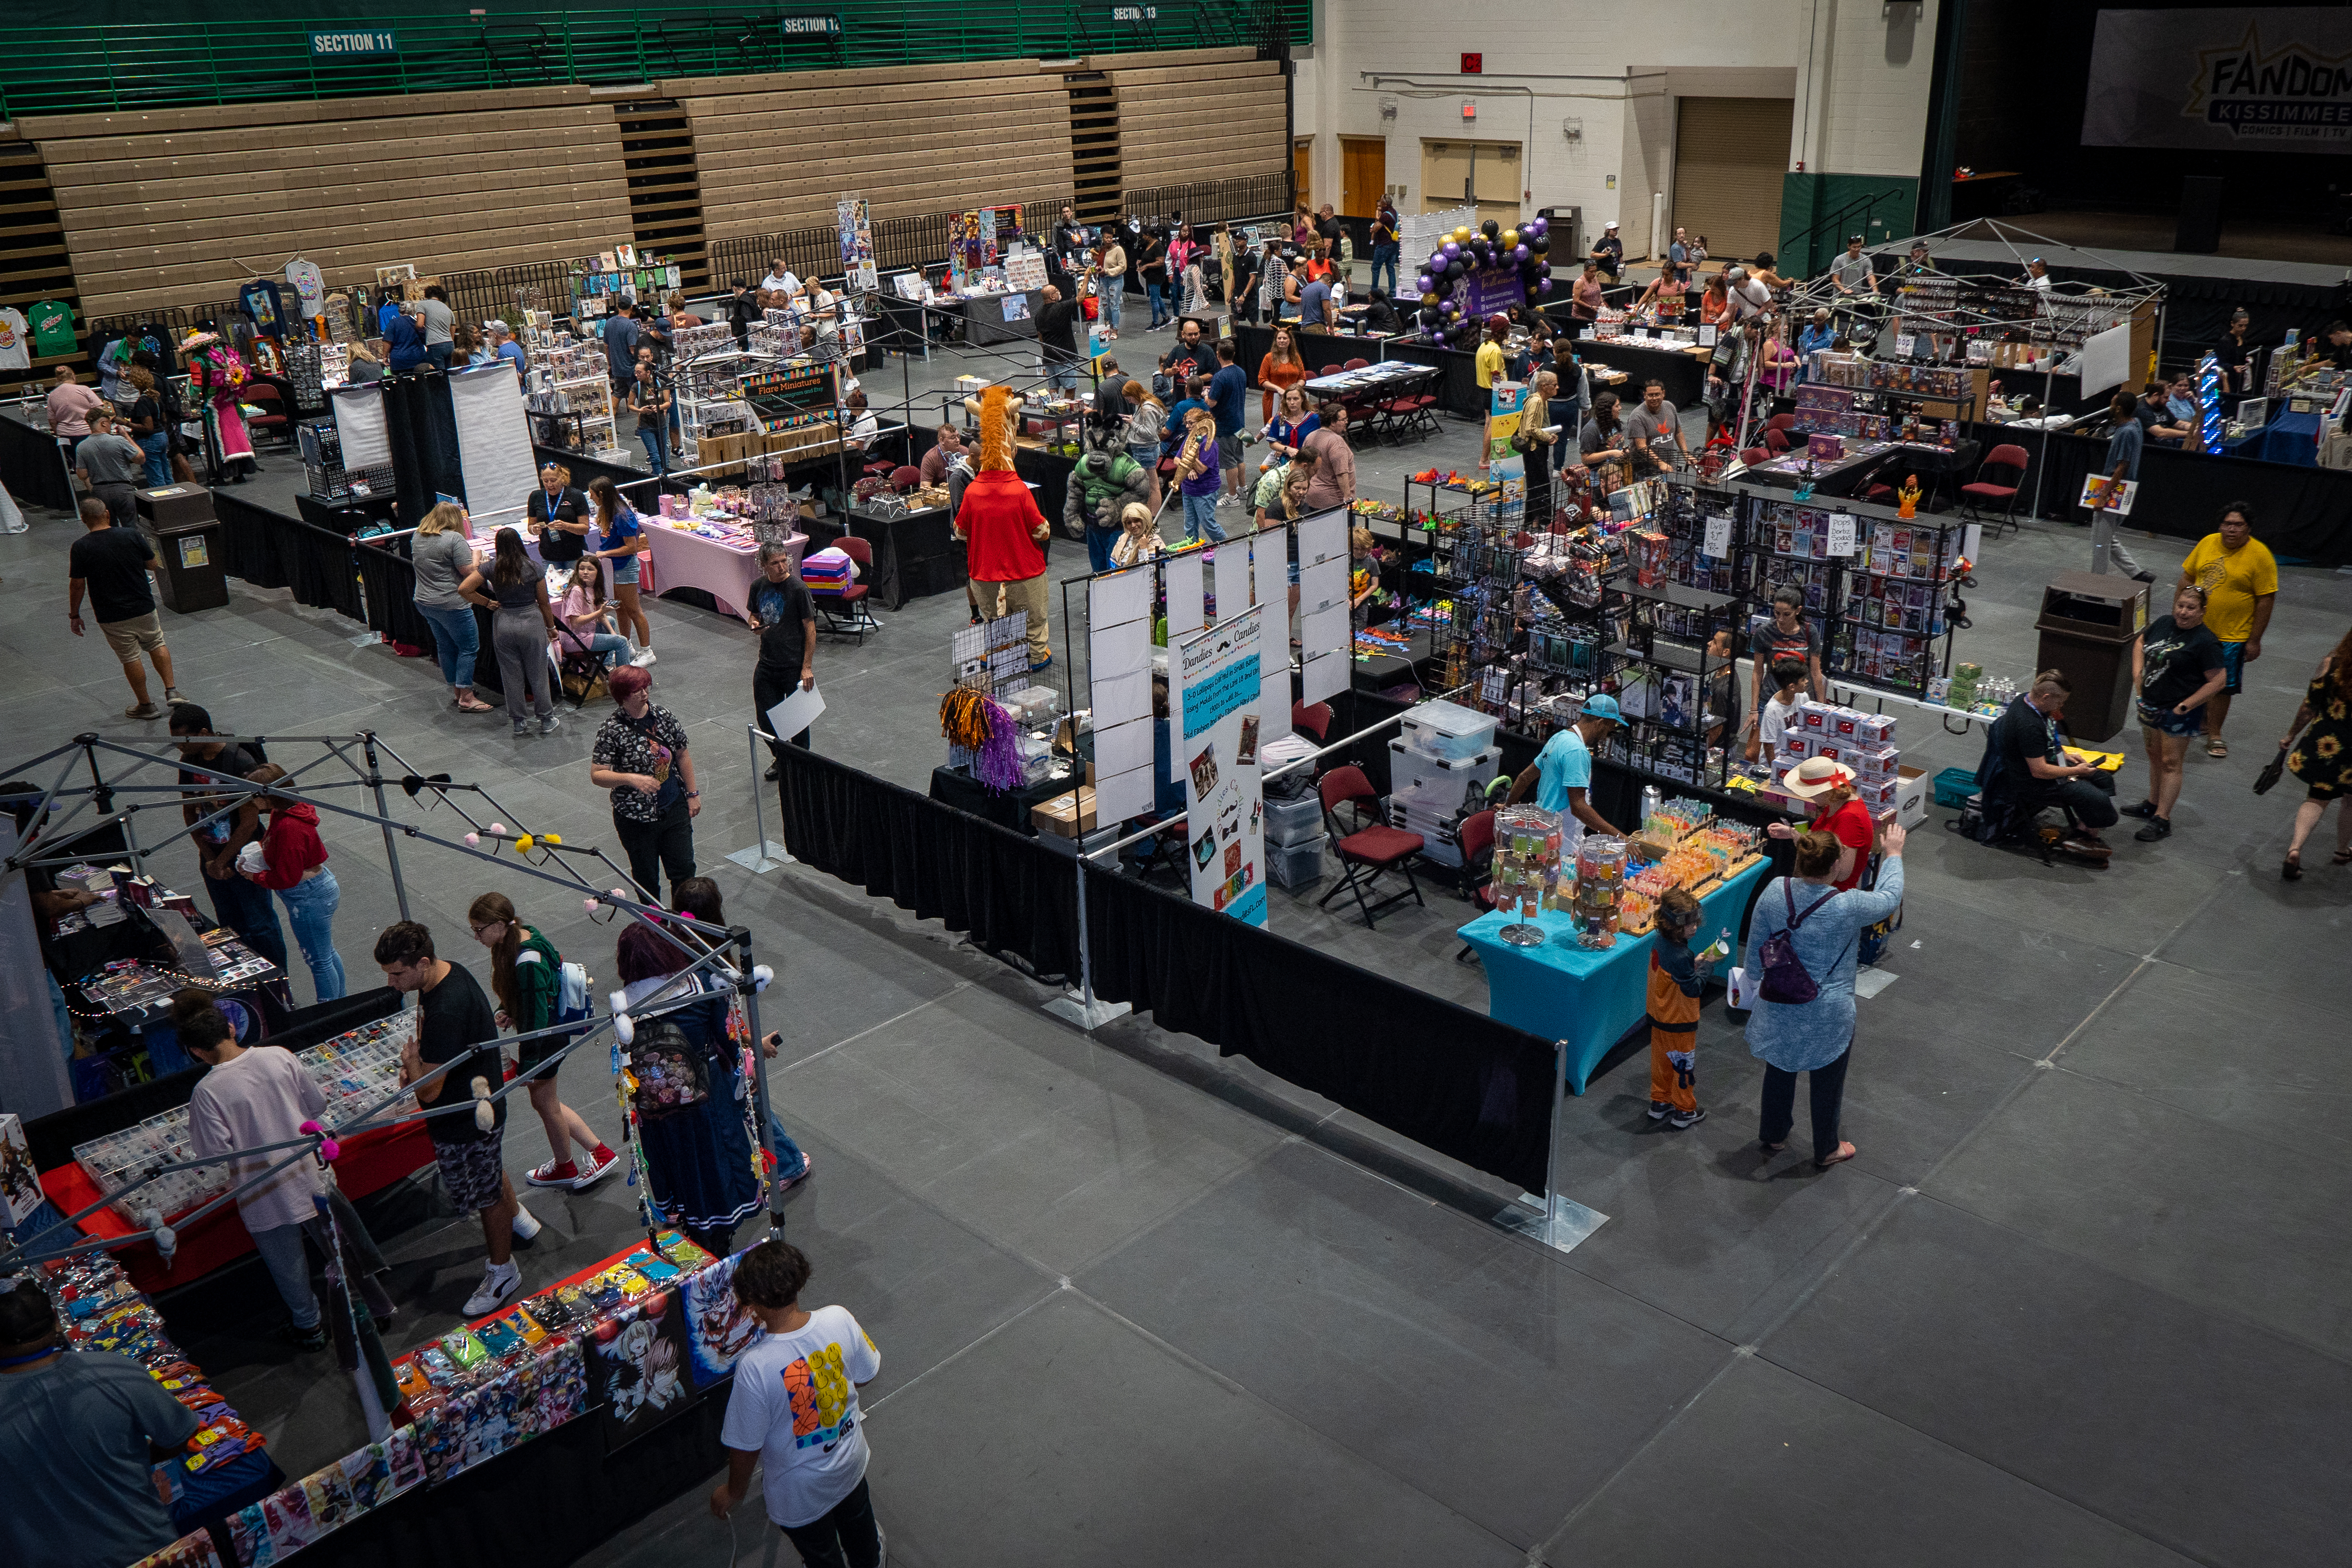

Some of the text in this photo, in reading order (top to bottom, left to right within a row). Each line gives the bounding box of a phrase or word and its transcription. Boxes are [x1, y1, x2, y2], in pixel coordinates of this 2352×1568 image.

[1147, 6, 1156, 18] 13
[785, 17, 826, 33] SECTION
[315, 34, 393, 52] SECTION 11
[2218, 104, 2352, 122] KISSIMMEE
[2240, 125, 2348, 137] COMICS FILM TV
[758, 378, 821, 395] Flare Miniatures
[1832, 519, 1850, 528] Pops
[1182, 622, 1260, 670] Dandies Candies
[1187, 691, 1196, 701] 3-D
[1197, 682, 1214, 696] Lollipops
[1215, 670, 1229, 685] Crafted
[1234, 662, 1245, 673] Small
[1246, 654, 1260, 667] Batches
[1199, 694, 1212, 707] Molds
[1230, 680, 1238, 689] Late
[1239, 675, 1244, 683] 18
[1210, 703, 1220, 714] 1900s
[1226, 693, 1234, 703] well
[1183, 730, 1193, 740] Old
[1194, 723, 1210, 735] Fashion
[1225, 703, 1240, 715] Fashion
[1240, 696, 1250, 705] Hard
